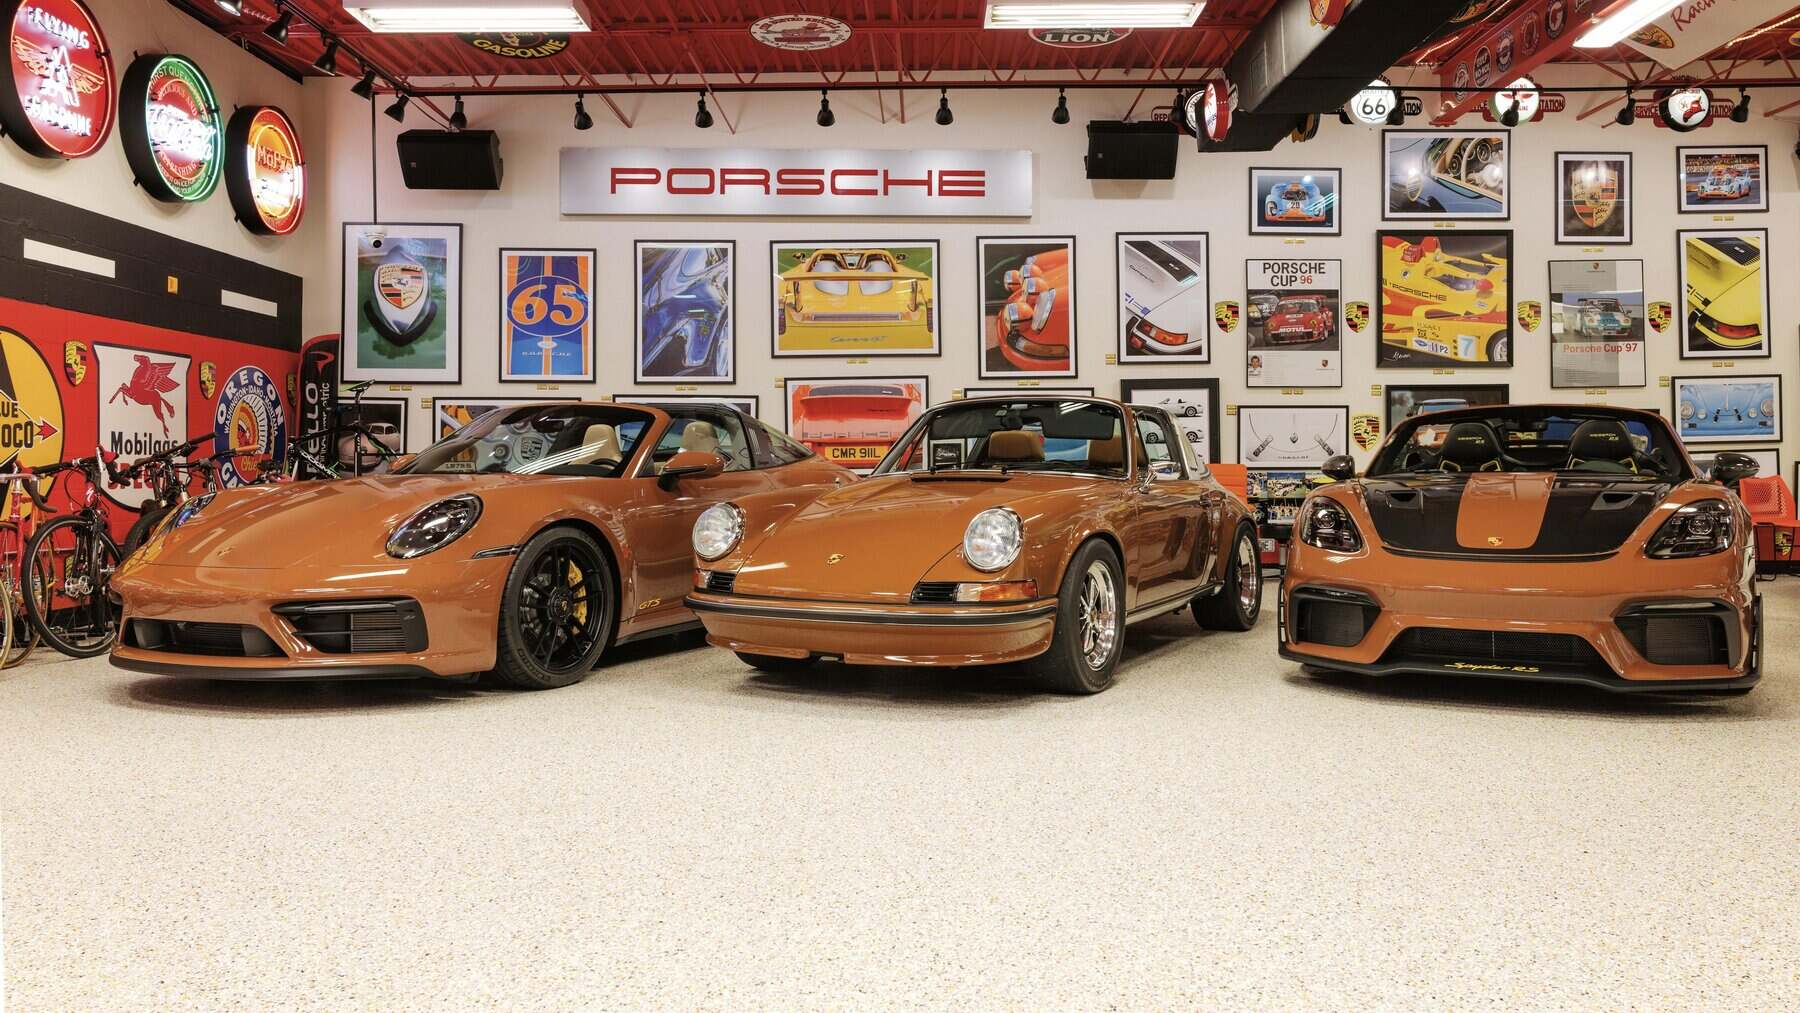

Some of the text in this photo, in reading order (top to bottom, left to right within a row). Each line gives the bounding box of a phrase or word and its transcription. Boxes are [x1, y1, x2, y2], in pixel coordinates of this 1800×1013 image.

[1043, 32, 1110, 43] LION
[473, 39, 567, 58] GASOLINE
[1362, 98, 1386, 115] 66
[1539, 99, 1564, 111] TATION
[1710, 105, 1733, 117] TATION
[610, 168, 985, 197] PORSCHE
[1263, 262, 1326, 274] PORSCHE
[1270, 275, 1313, 287] CUP 96
[1391, 283, 1448, 301] PORSCHE
[511, 284, 585, 325] 65
[1460, 338, 1474, 357] 7
[1563, 343, 1602, 353] Porsche
[1603, 343, 1622, 354] Cup
[217, 369, 284, 426] OREGON
[0, 401, 19, 418] UE
[1, 421, 34, 449] OCO
[305, 382, 319, 473] RELLO
[832, 448, 856, 458] CMR
[639, 598, 662, 610] GTS
